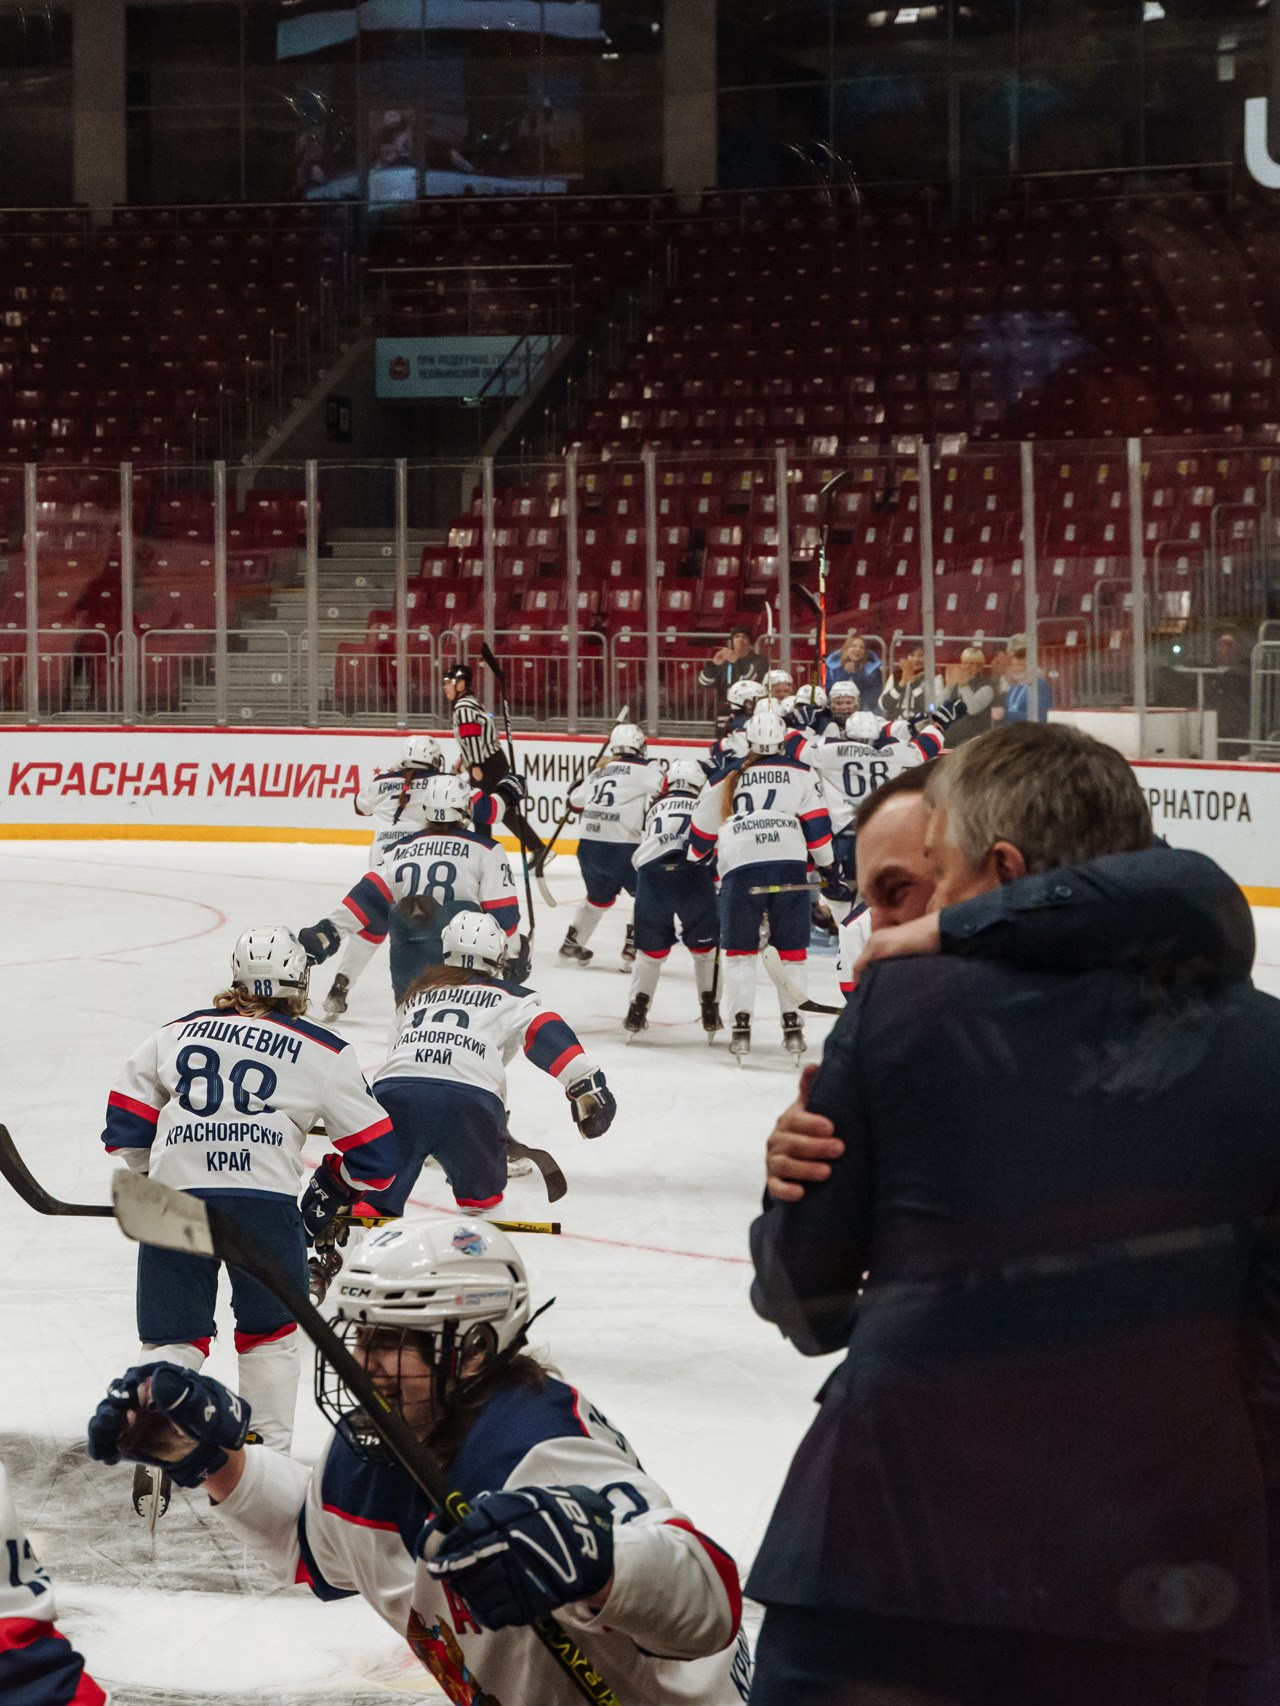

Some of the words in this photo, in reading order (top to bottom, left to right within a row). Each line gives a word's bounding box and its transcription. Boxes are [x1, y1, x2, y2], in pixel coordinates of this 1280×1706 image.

[759, 744, 770, 753] 94
[8, 762, 199, 796] КРАСНАЯ
[206, 763, 361, 799] МАШИНА
[434, 809, 446, 821] 28
[652, 812, 692, 835] 17
[755, 831, 781, 844] КРАЙ
[393, 841, 470, 861] МЕЗЕНЦЕВА
[395, 861, 457, 905] 28
[460, 955, 474, 969] 18
[254, 979, 273, 997] 88
[177, 1020, 303, 1065] ЛЯШКЕВИЧ
[415, 1049, 452, 1066] КРАЙ
[176, 1045, 277, 1118] 88
[165, 1123, 283, 1147] КРАСНОЯРСКИЙ
[207, 1149, 251, 1172] КРАЙ
[340, 1285, 372, 1298] CCM
